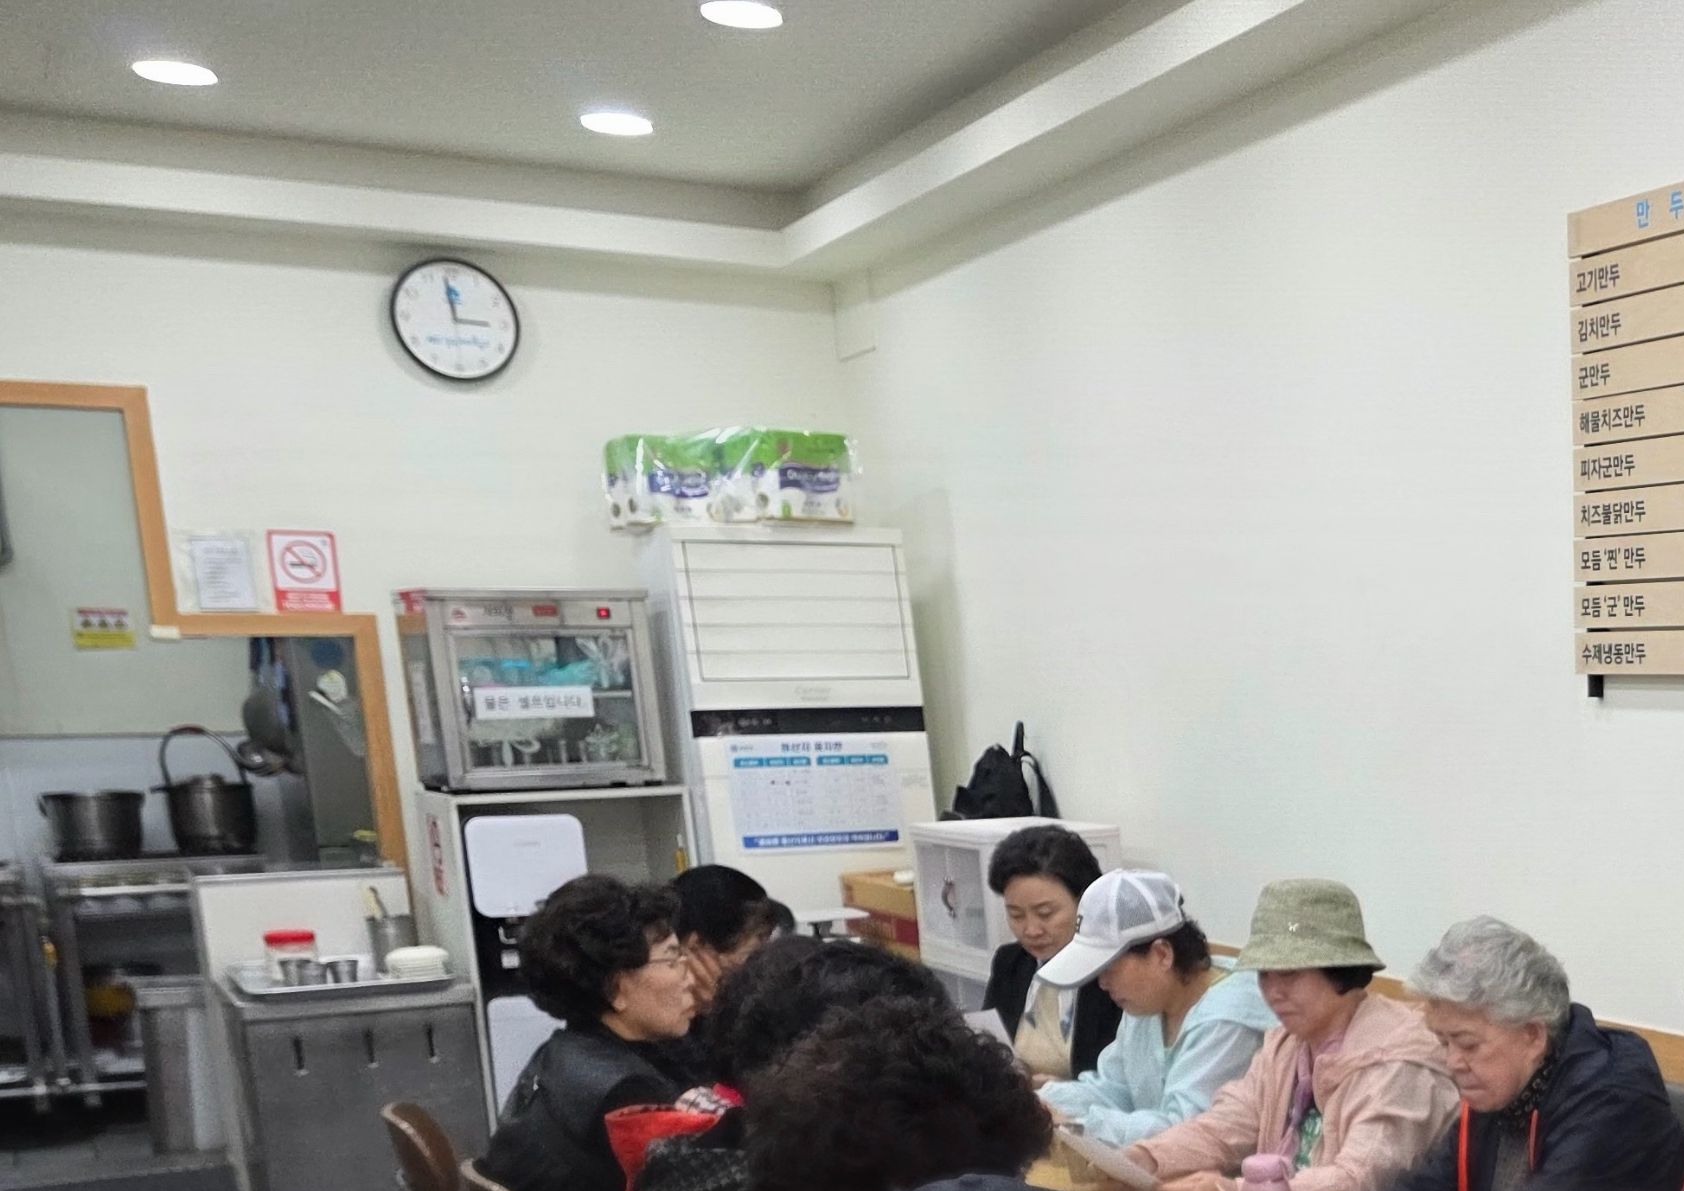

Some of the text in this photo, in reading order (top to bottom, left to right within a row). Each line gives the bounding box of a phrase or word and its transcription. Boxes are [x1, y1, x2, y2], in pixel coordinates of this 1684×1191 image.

[1576, 264, 1620, 293] 고기만두
[1578, 313, 1621, 342] 김치만두
[1579, 363, 1610, 389] 군만두
[1580, 405, 1645, 433] 해물치즈만두
[1581, 454, 1635, 480] 피자군만두
[1581, 501, 1646, 525] 치즈불닭만두
[1581, 550, 1601, 571] 모듬
[1624, 547, 1646, 569] 만두
[1581, 597, 1601, 618] 모듬
[1623, 595, 1645, 617] 만두
[1582, 643, 1646, 664] 수제냉동만두
